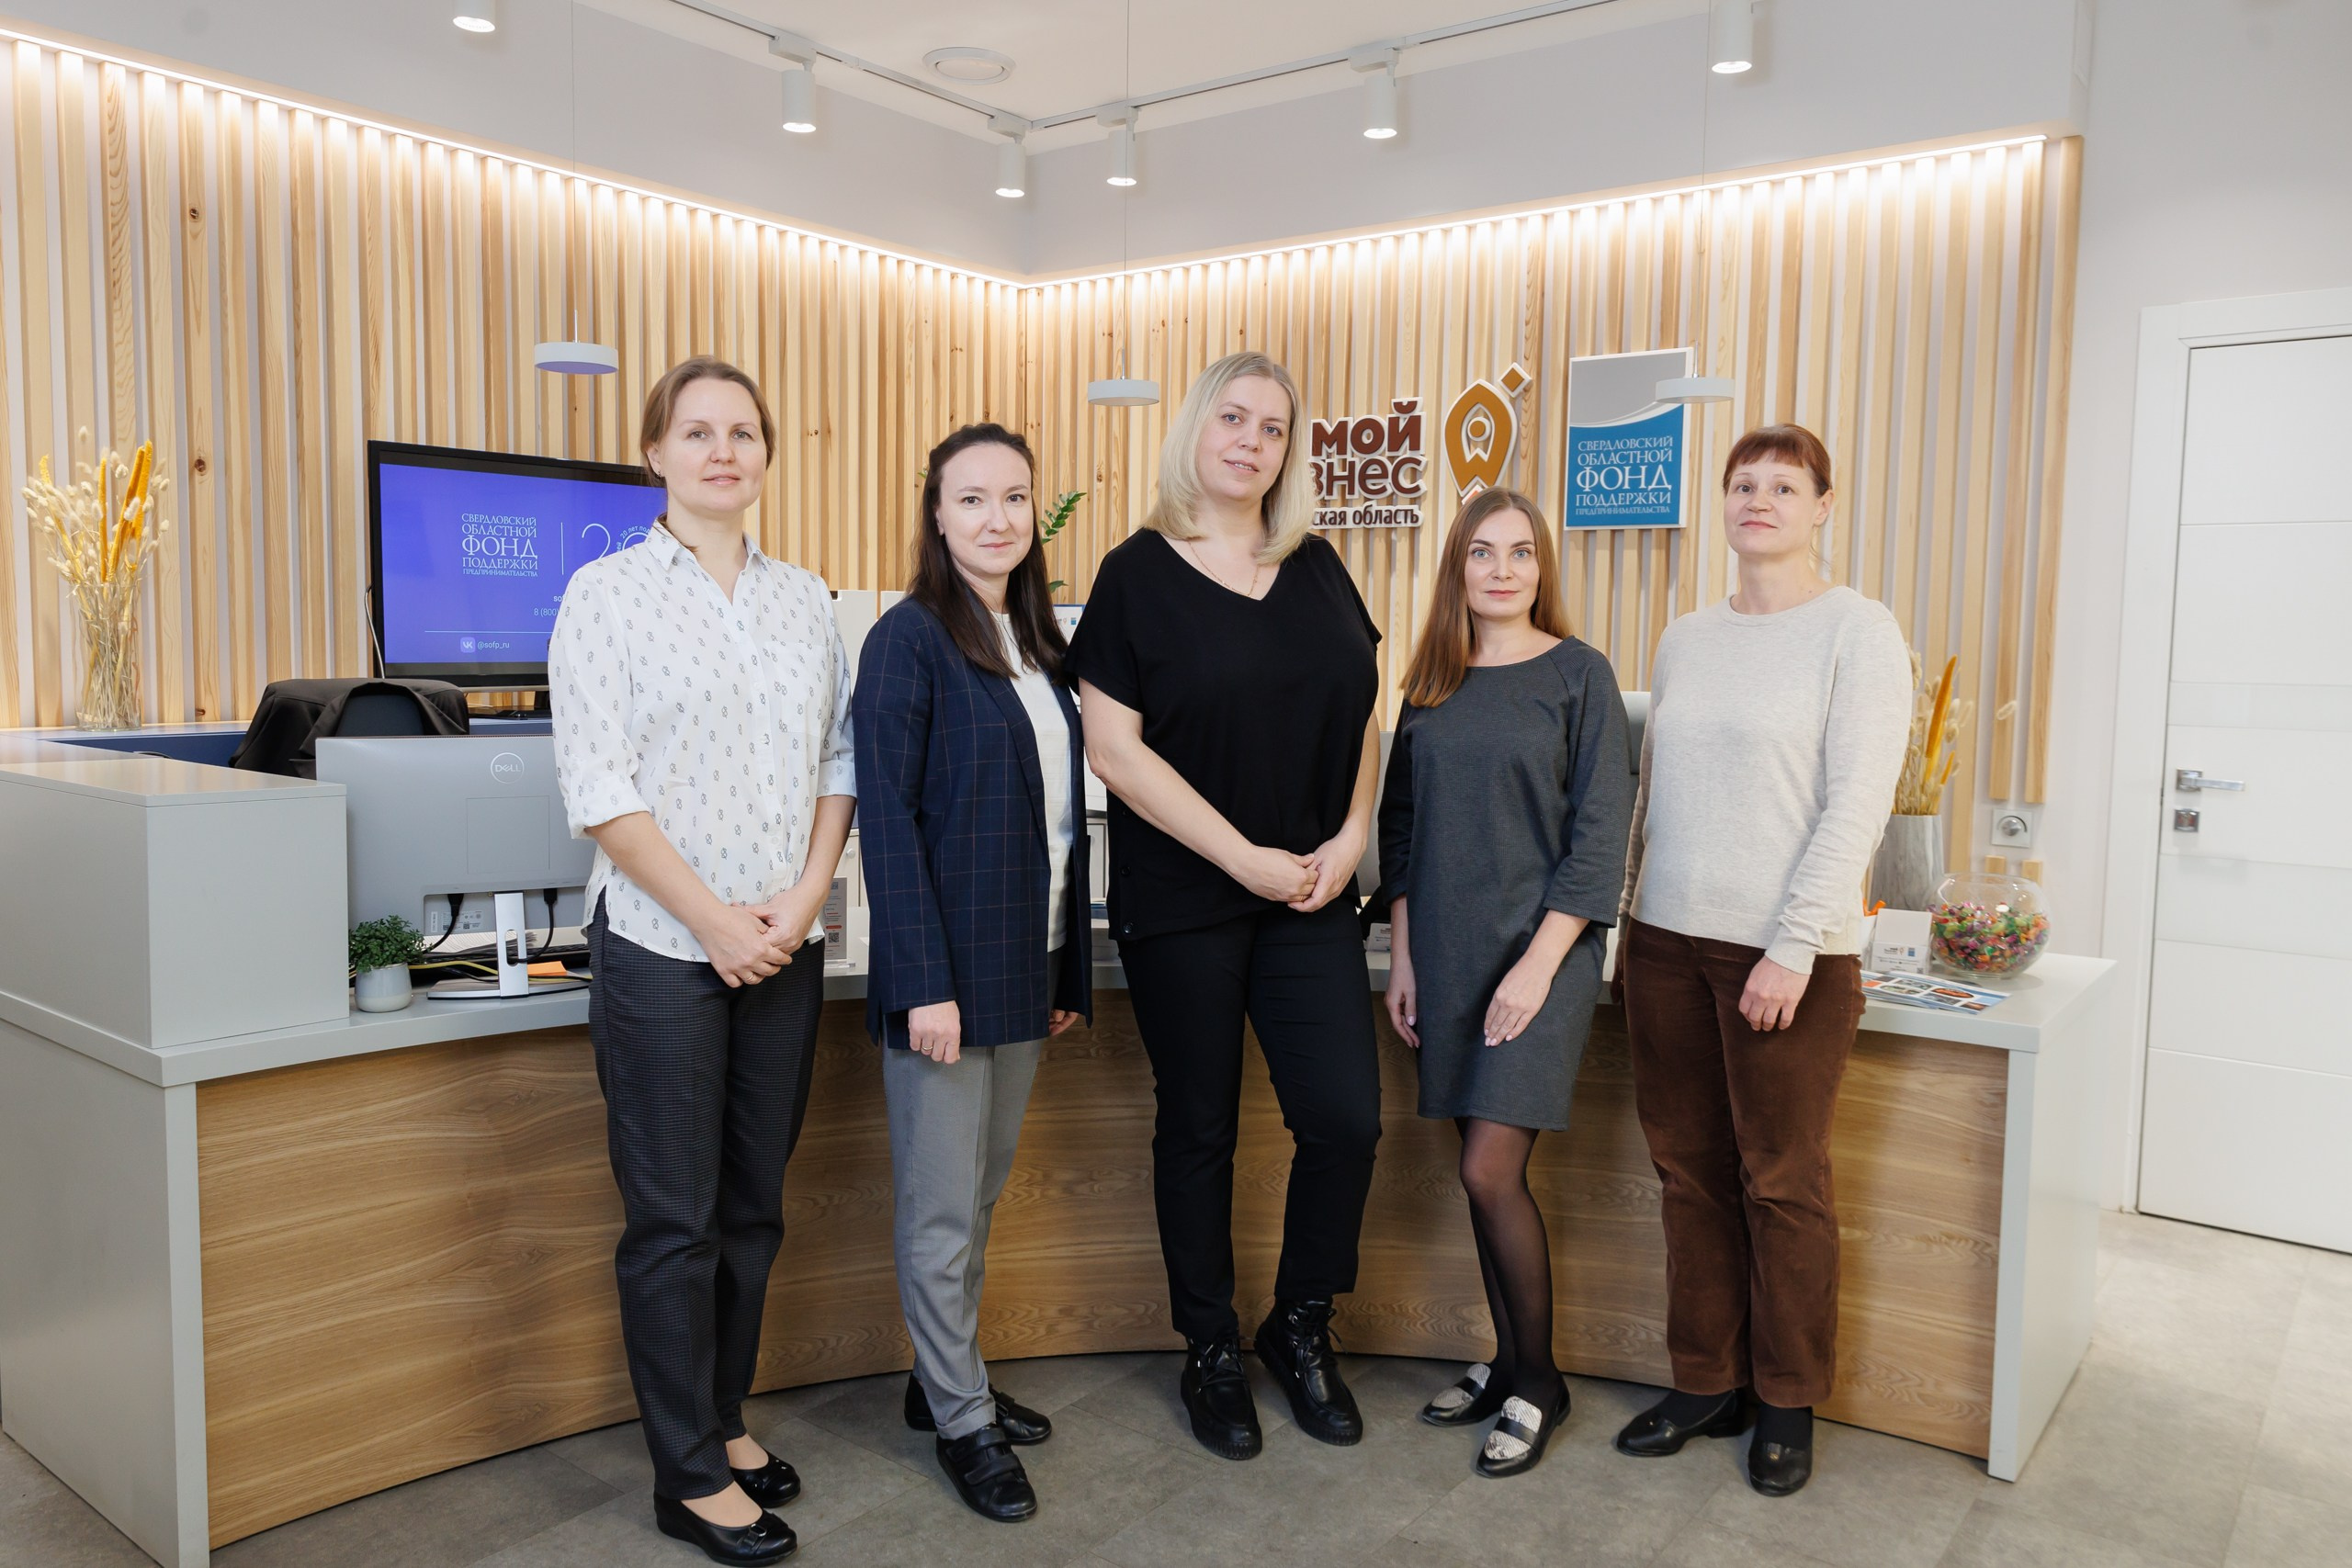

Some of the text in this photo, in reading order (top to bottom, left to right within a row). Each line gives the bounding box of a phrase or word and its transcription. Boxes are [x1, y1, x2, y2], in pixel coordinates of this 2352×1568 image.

[1577, 435, 1673, 451] СВЕРДЛОВСКИЙ
[1577, 448, 1672, 466] ОБЛАСТНОЙ
[1576, 464, 1672, 492] ФОНД
[1576, 491, 1671, 507] ПОДДЕРЖКИ
[461, 513, 537, 526] СВЕРДЛОВСКИЙ
[1352, 503, 1419, 525] область
[461, 523, 537, 538] ОБЛАСТНОЙ
[461, 535, 538, 559] ФОНД
[462, 557, 538, 570] ПОДДЕРЖКИ
[534, 607, 538, 616] 8
[477, 640, 510, 650] @sofp_ru
